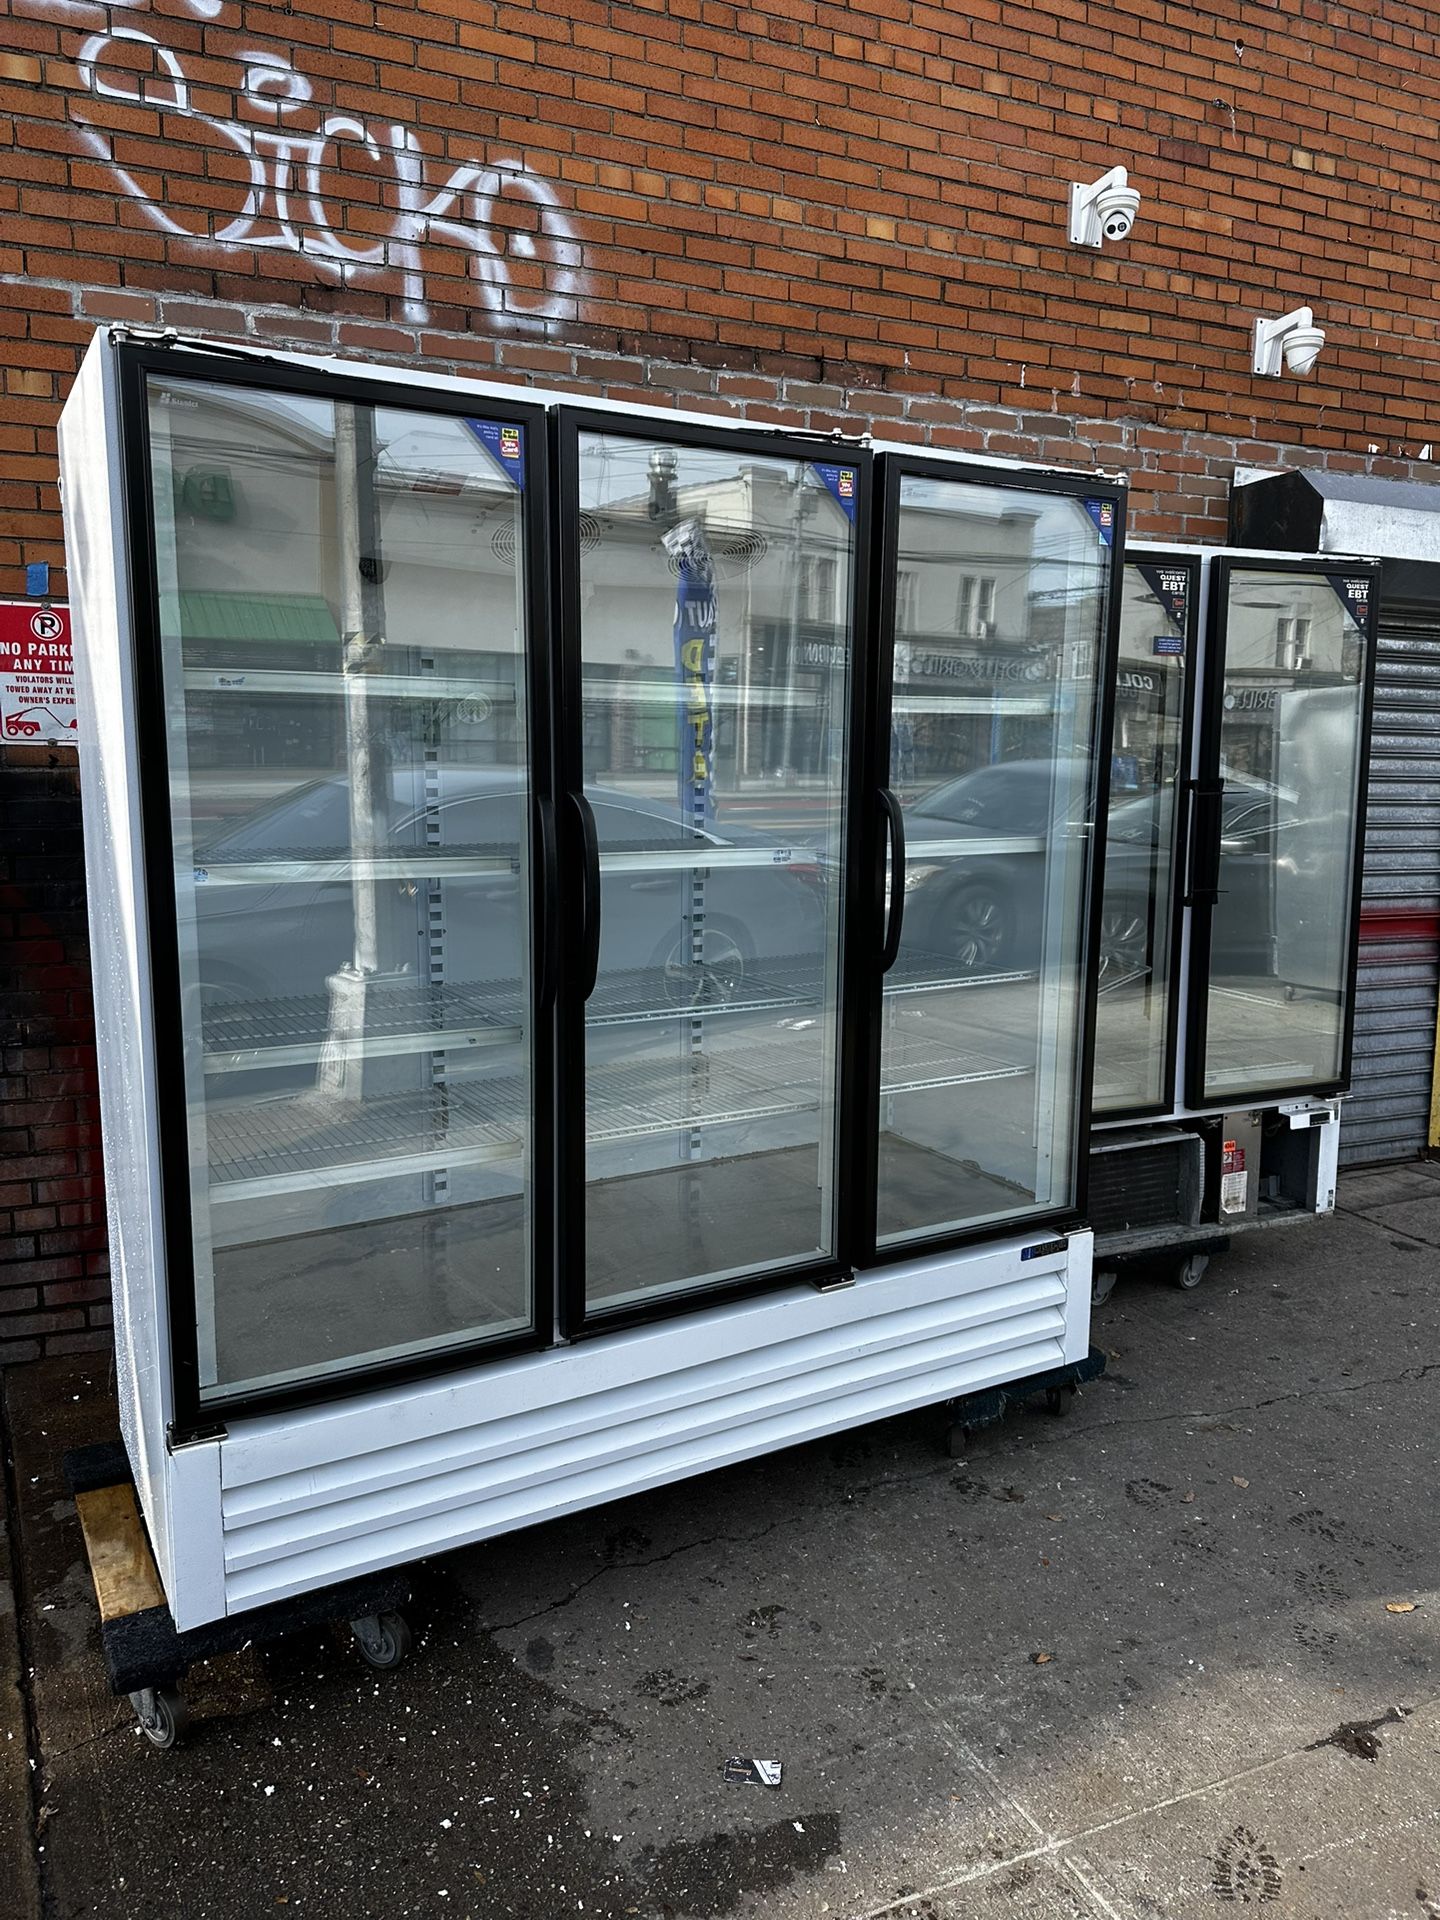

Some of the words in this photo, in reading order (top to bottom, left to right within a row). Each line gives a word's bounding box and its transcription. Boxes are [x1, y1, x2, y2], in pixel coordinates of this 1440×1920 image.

[1160, 574, 1186, 582] QUEST
[1162, 581, 1186, 591] EBT
[1348, 590, 1369, 599] EBT
[0, 642, 21, 655] NO
[13, 659, 42, 671] ANY
[15, 675, 54, 684] VIOLATORS
[55, 676, 73, 685] WILL
[6, 685, 30, 694] TOWED
[32, 685, 53, 694] AWAY
[55, 686, 64, 695] AT
[18, 695, 51, 704] OWNER'S
[52, 696, 76, 705] EXPEN
